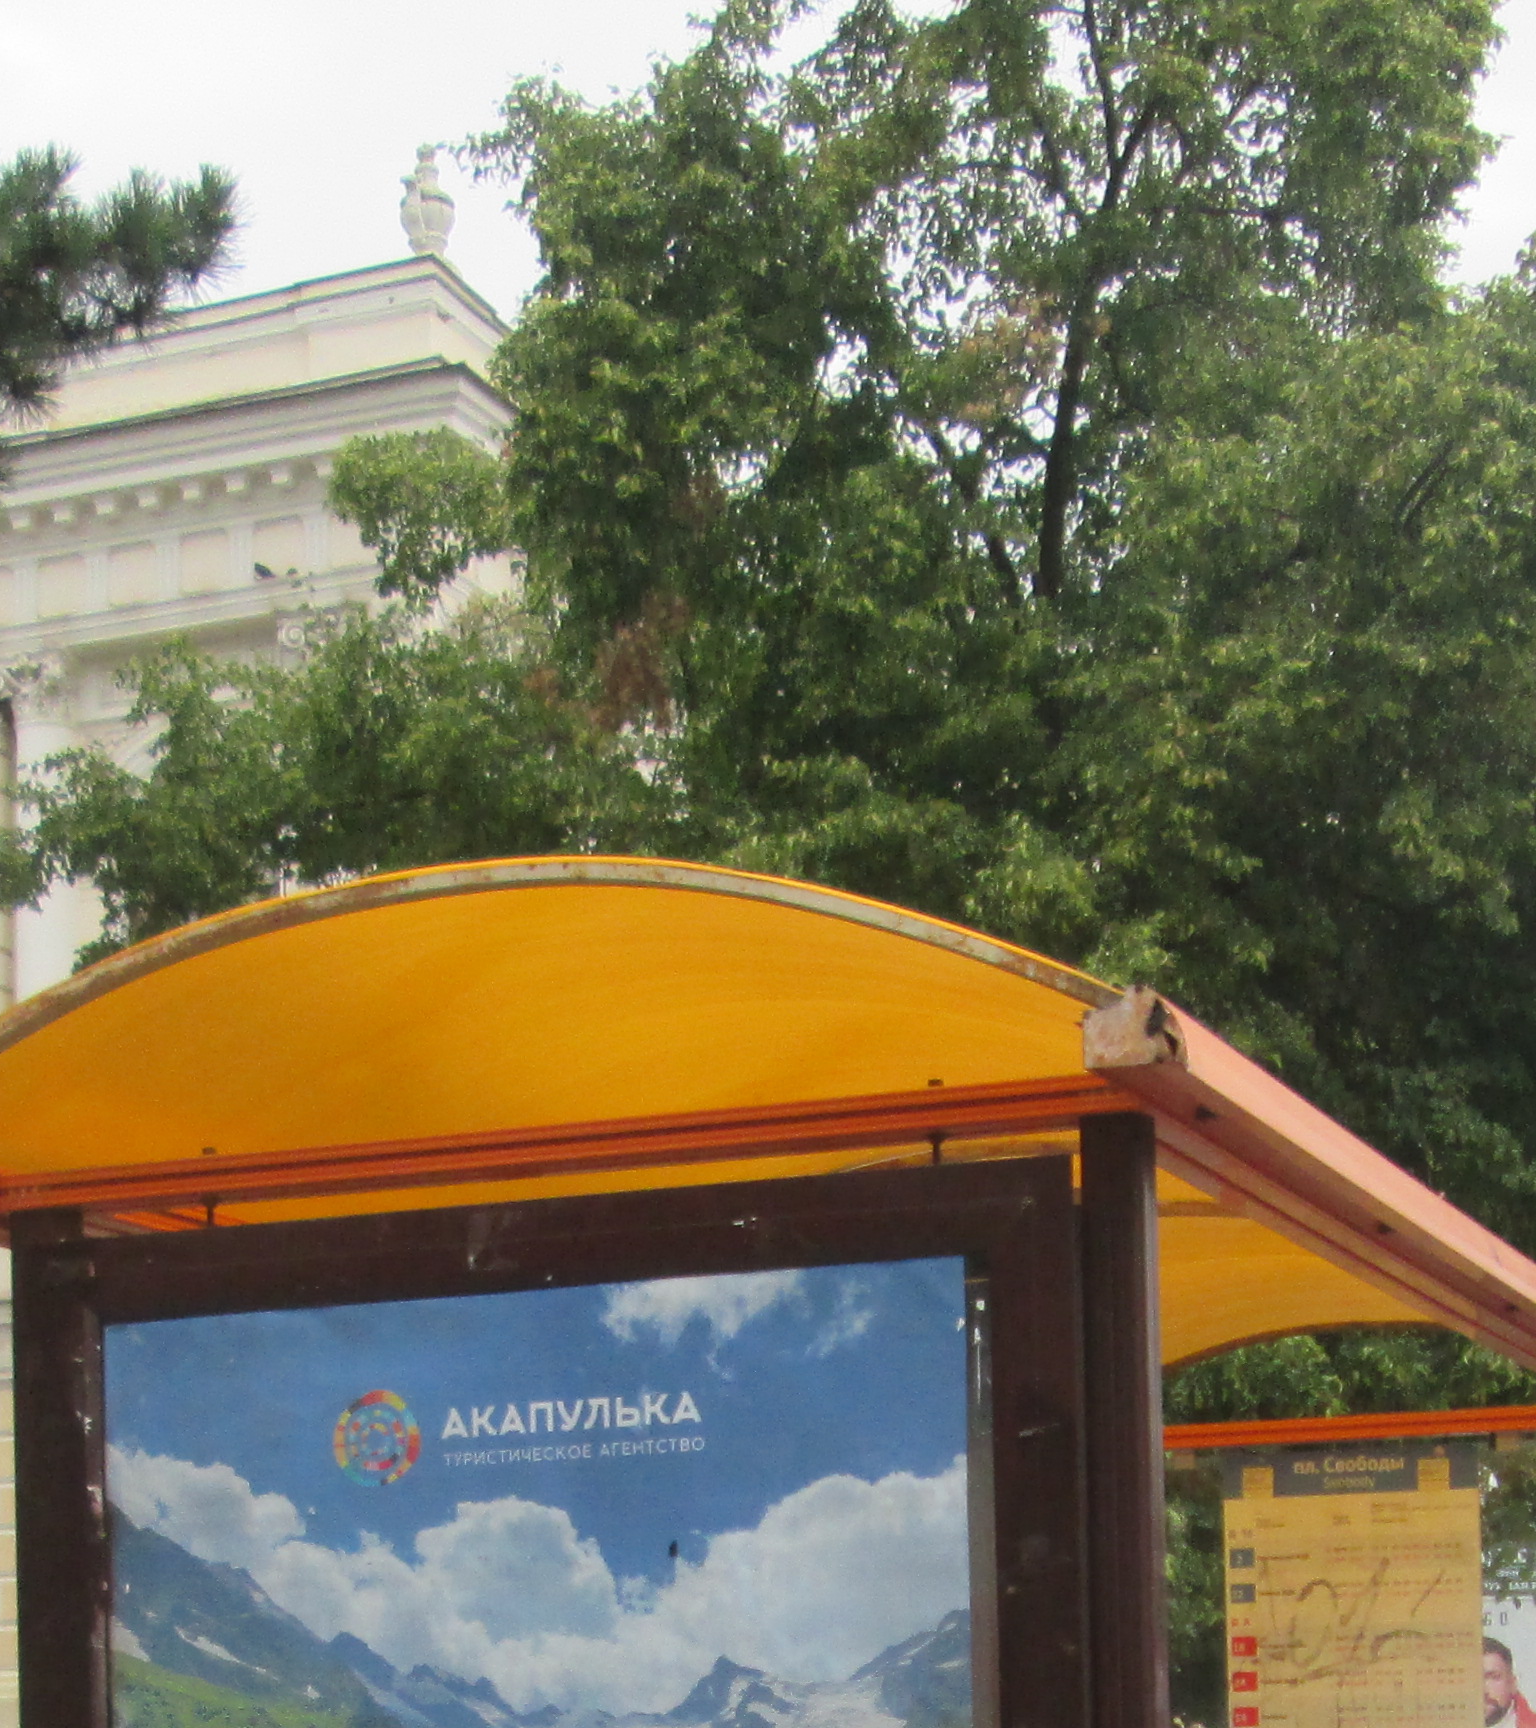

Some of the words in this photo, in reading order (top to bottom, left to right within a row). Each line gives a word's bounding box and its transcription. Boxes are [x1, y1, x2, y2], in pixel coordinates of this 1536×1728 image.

[441, 1391, 701, 1440] АКАПУЛЬКА
[443, 1446, 592, 1467] ТУРИСТИЧЕСКОЕ
[600, 1437, 706, 1457] АГЕНТСТВО
[1323, 1455, 1405, 1473] Свободы
